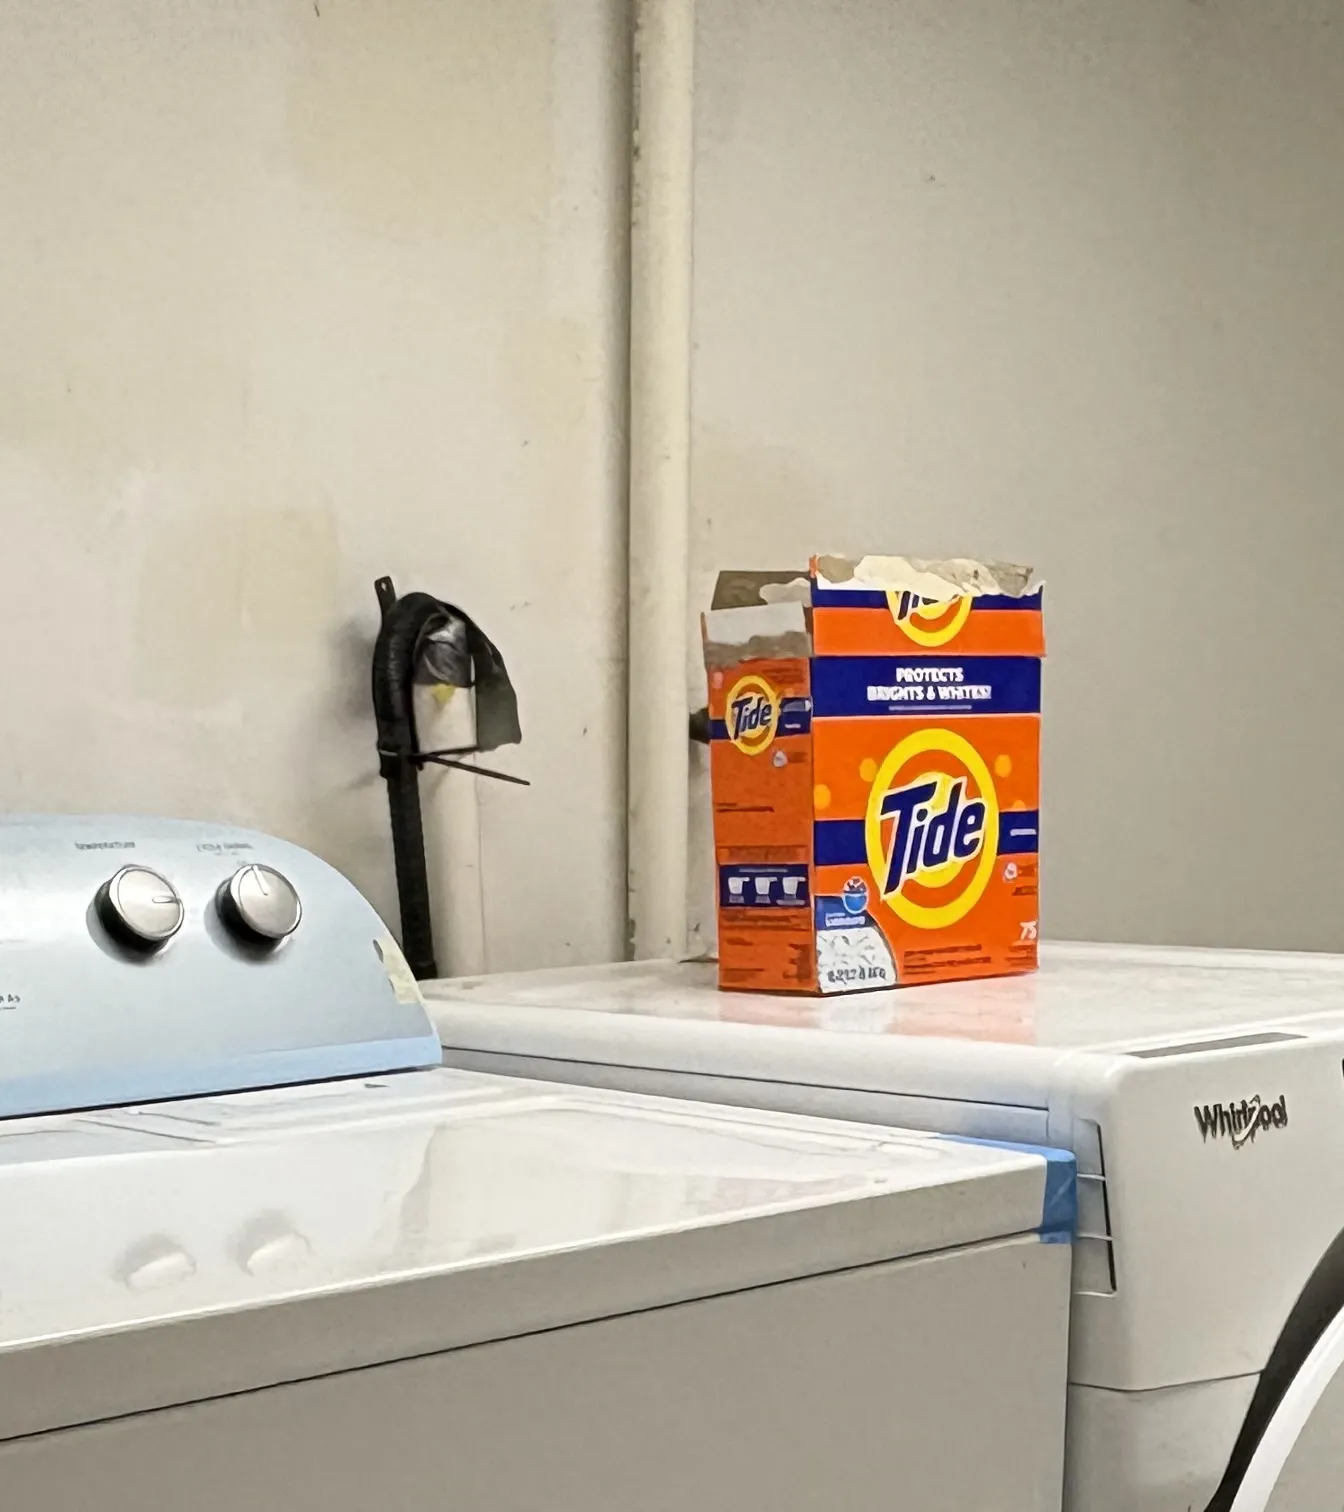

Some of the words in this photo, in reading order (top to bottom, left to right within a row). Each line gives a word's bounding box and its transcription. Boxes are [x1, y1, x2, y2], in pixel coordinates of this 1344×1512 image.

[731, 696, 772, 740] Tide
[880, 780, 985, 895] Tide
[1194, 1094, 1288, 1149] Whirlpool
